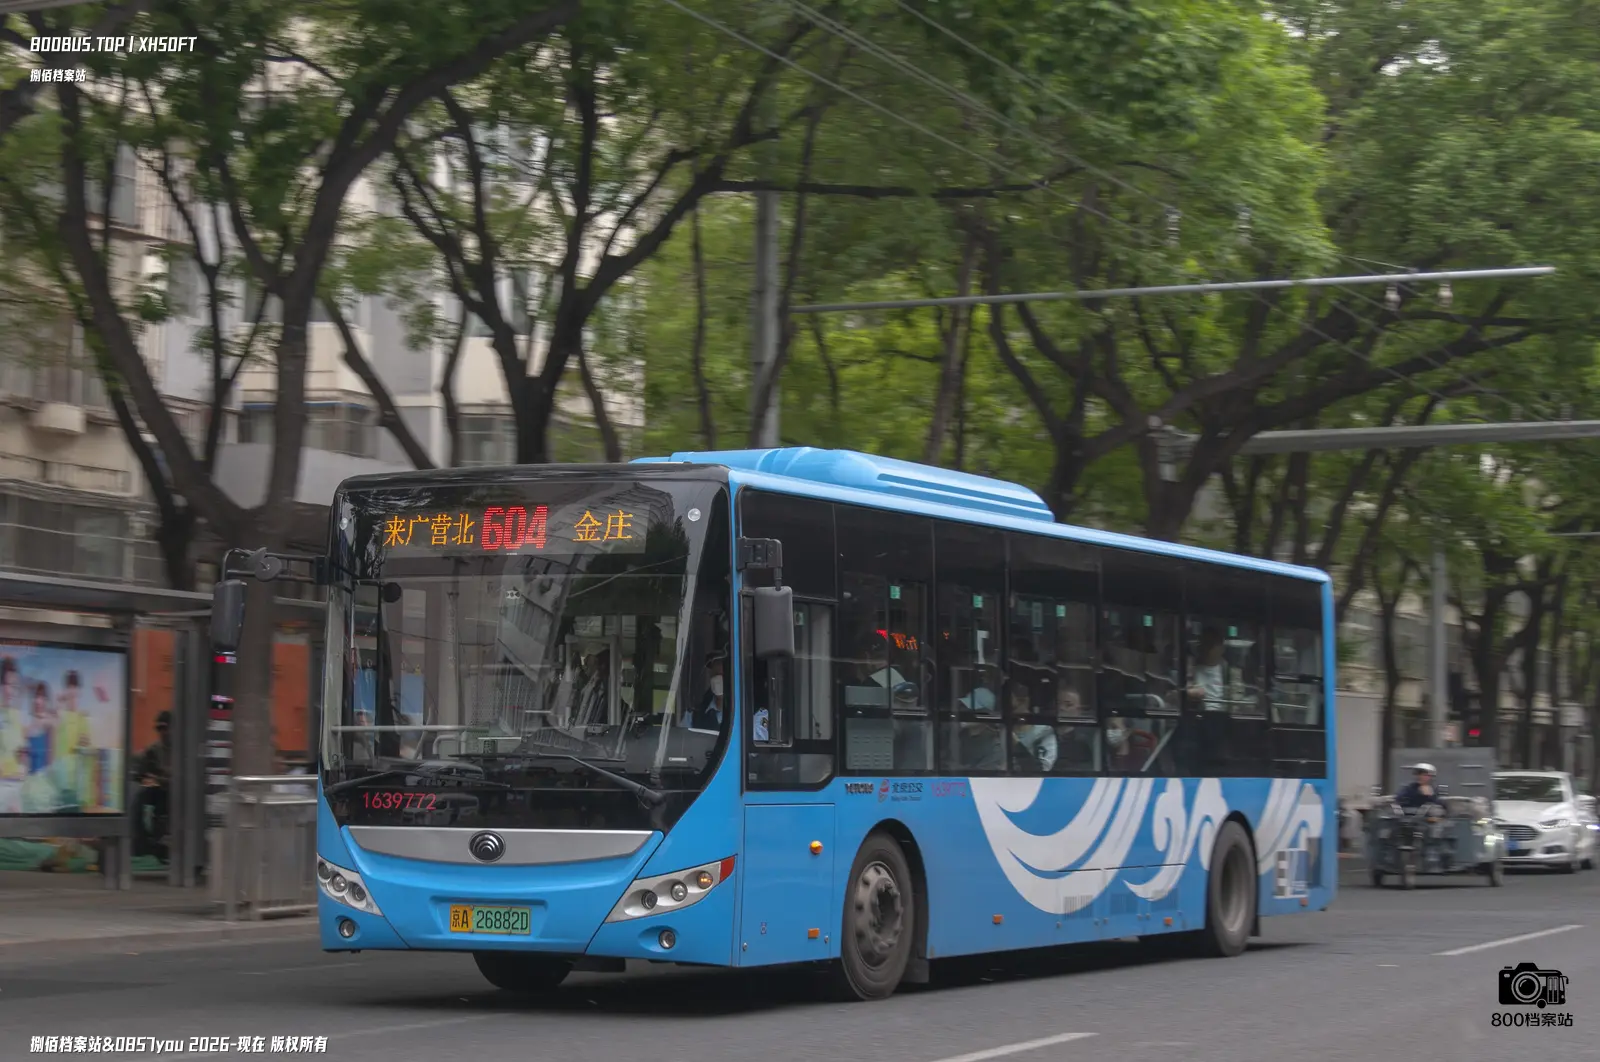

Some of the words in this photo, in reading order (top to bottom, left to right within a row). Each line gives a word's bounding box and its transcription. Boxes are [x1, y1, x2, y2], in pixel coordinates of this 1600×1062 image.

[383, 513, 475, 547] 来广营北
[481, 505, 549, 550] 604
[572, 509, 634, 543] 金庄
[362, 791, 437, 811] 1639772
[451, 909, 470, 929] 京A
[476, 910, 529, 931] 26882D
